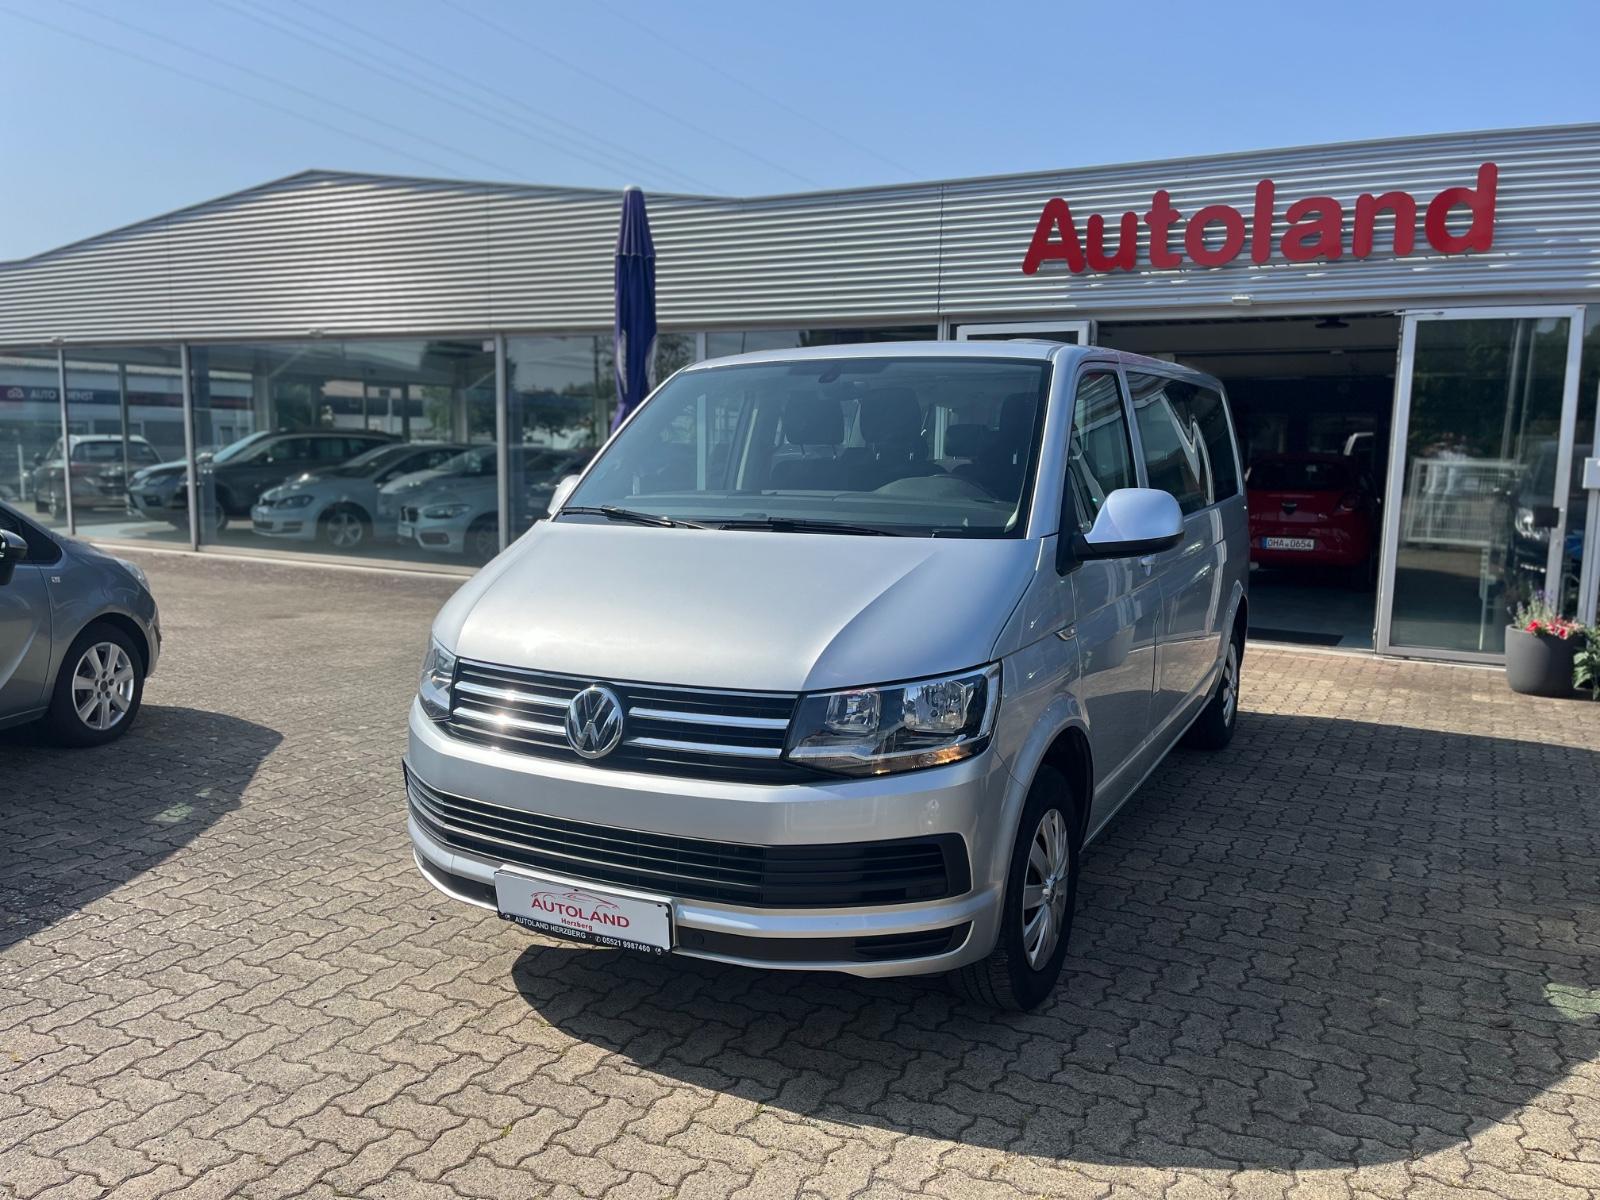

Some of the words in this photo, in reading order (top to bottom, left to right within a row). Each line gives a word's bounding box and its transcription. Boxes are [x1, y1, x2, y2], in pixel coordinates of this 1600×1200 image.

[1022, 162, 1498, 275] Autoland
[531, 897, 630, 928] AUTOLAND
[560, 917, 593, 932] Herzberg
[514, 916, 549, 930] AUTOLAND
[550, 925, 587, 939] HERZBERG
[602, 936, 622, 947] 05521
